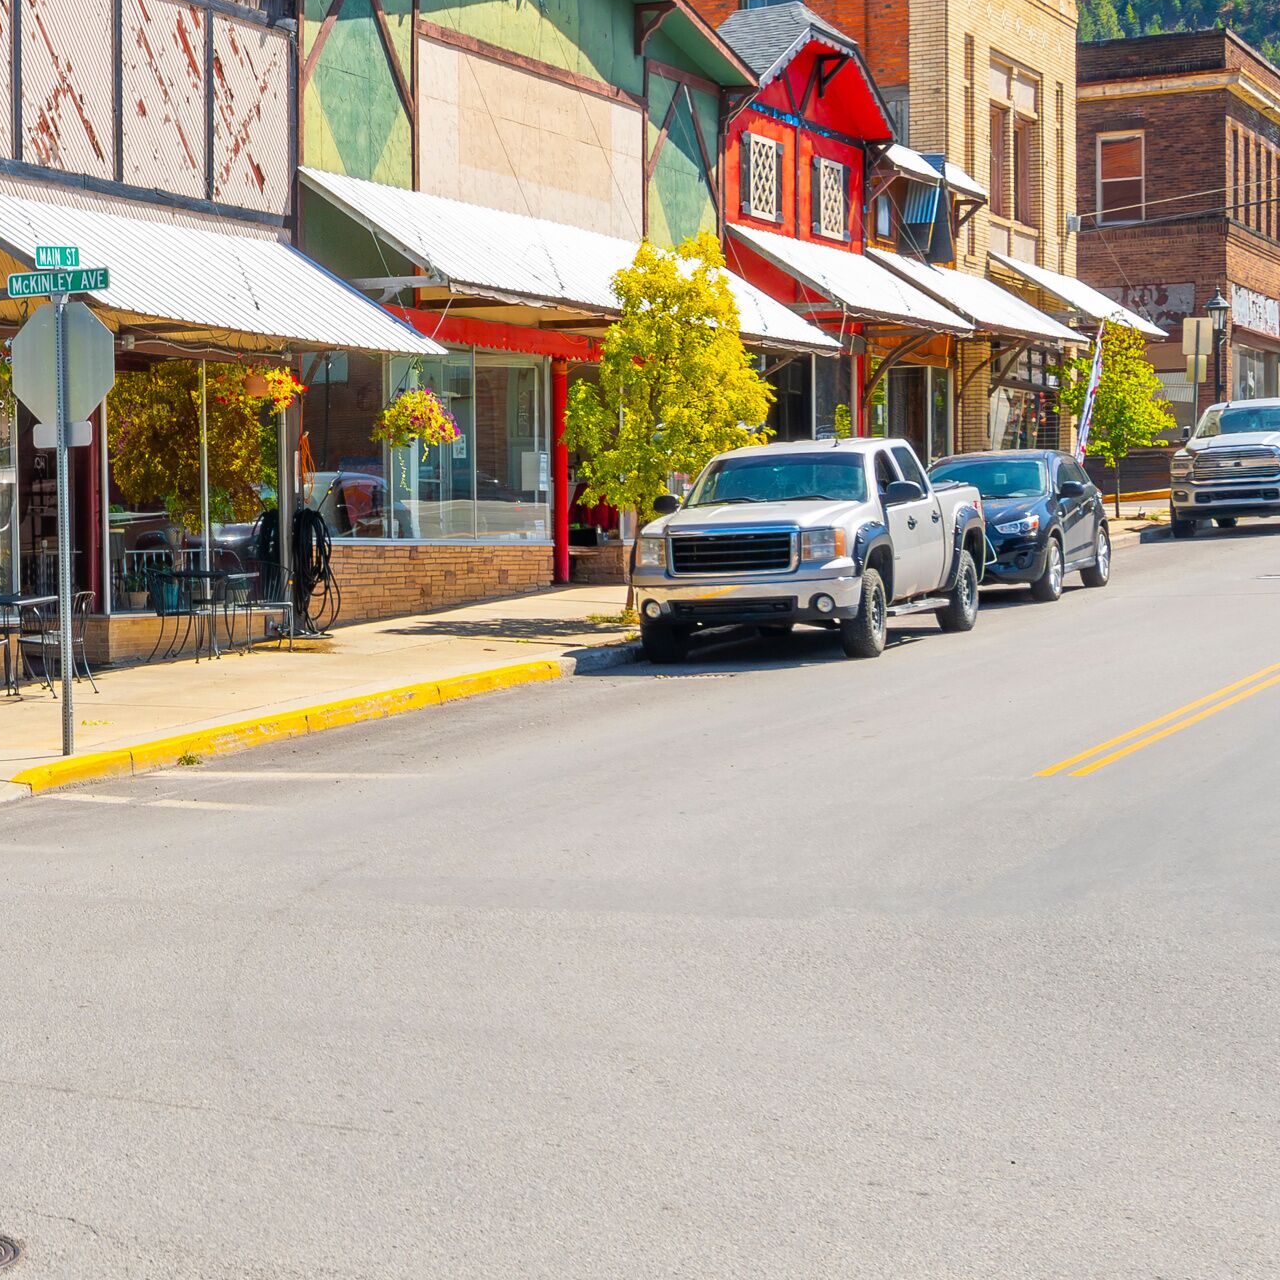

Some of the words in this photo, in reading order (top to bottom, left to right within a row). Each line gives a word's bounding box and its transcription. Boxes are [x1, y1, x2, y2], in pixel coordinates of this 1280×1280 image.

[39, 248, 60, 266] MAIN
[66, 248, 76, 266] ST
[12, 273, 73, 294] McKINLEY
[81, 270, 105, 289] AVE
